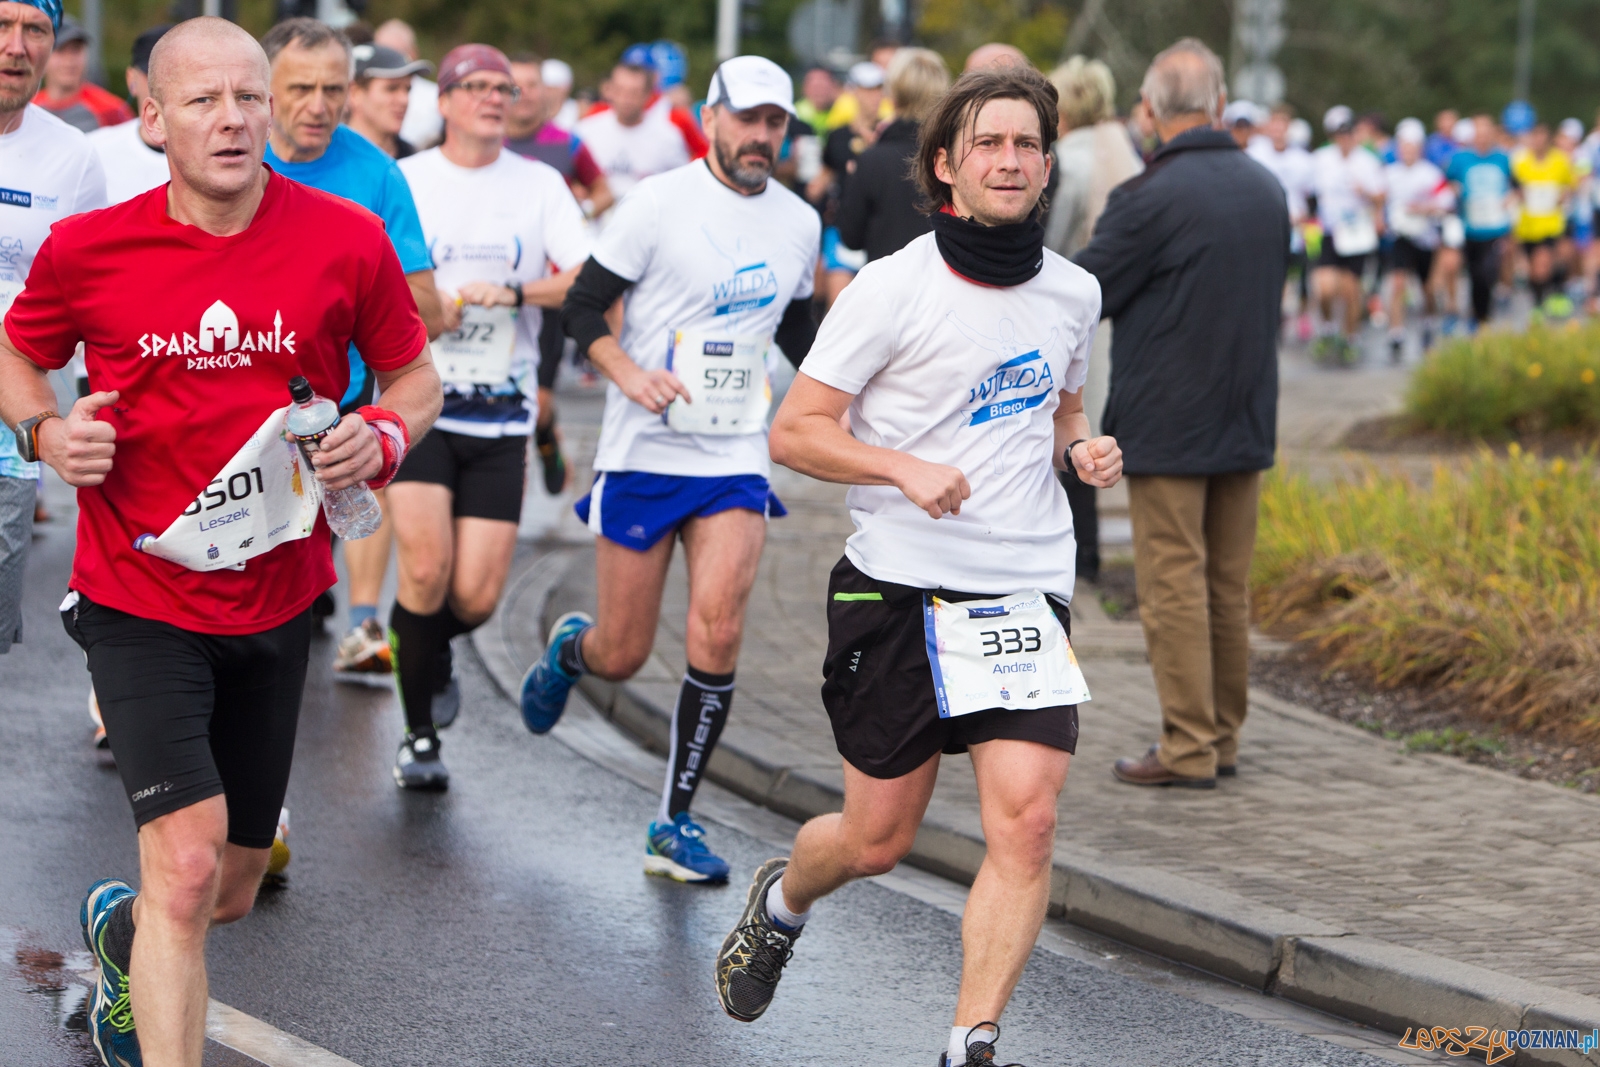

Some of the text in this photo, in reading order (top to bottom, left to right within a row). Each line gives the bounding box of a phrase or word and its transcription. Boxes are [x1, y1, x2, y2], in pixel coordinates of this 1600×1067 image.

[12, 193, 30, 204] PKO
[713, 270, 778, 301] WILDA
[704, 368, 751, 390] 5731
[968, 362, 1054, 403] WILDA
[199, 507, 251, 532] Leszek
[980, 627, 1041, 657] 333
[992, 660, 1037, 674] Andrzej
[131, 783, 162, 802] CRAFT
